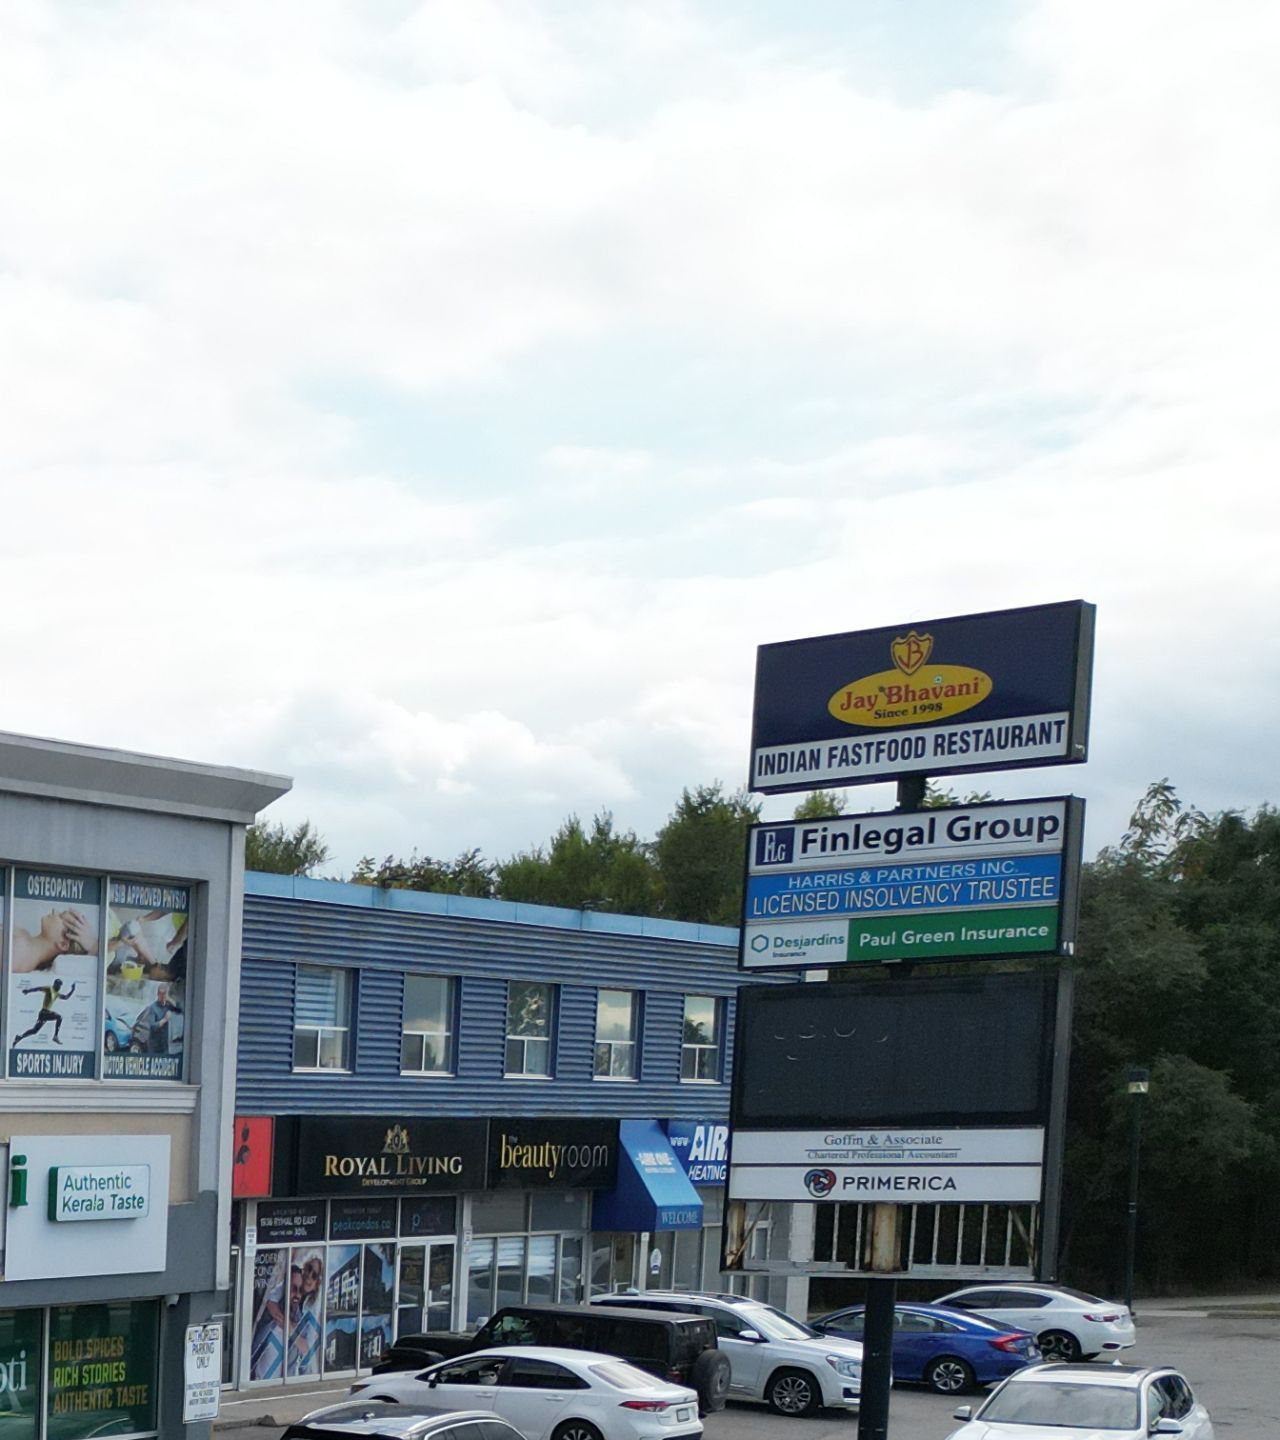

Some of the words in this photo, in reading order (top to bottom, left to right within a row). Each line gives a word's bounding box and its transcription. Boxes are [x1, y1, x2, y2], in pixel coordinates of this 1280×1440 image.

[840, 691, 878, 711] Jay
[885, 677, 979, 704] Bhavani
[874, 708, 909, 719] Since
[912, 703, 942, 715] 1998
[758, 748, 820, 777] INDIAN
[827, 735, 926, 769] FASTFOOD
[934, 719, 1066, 757] RESTAURANT
[801, 817, 936, 854] Finlegal
[947, 814, 1059, 843] Group
[789, 872, 854, 889] HARRIS
[859, 871, 871, 884] &
[877, 864, 976, 883] PARTNERS
[982, 860, 1019, 875] INC.
[27, 875, 83, 900] OSTEOPATHY
[753, 892, 839, 915] LICENSED
[845, 883, 962, 909] INSOLVENCY
[968, 877, 1055, 899] TRUSTEE
[773, 934, 845, 950] Desjardins
[860, 930, 895, 948] Paul
[902, 928, 955, 945] Green
[962, 924, 1049, 941] Insurance
[17, 1053, 50, 1073] SPORTS
[52, 1054, 84, 1075] INJURY
[867, 1135, 878, 1146] &
[325, 1155, 390, 1176] ROYAL
[396, 1154, 463, 1176] LIVING
[688, 1165, 727, 1181] HEATING
[63, 1172, 132, 1192] Authentic
[843, 1176, 957, 1191] PRIMERICA
[62, 1195, 105, 1213] Kerala
[110, 1193, 145, 1210] Taste
[662, 1211, 698, 1224] WELCOME
[54, 1341, 83, 1361] BOLD
[86, 1336, 125, 1358] SPICES
[53, 1366, 79, 1388] RICH
[82, 1362, 126, 1383] STORIES
[53, 1388, 113, 1414] AUTHENTIC
[117, 1385, 148, 1407] TASTE
